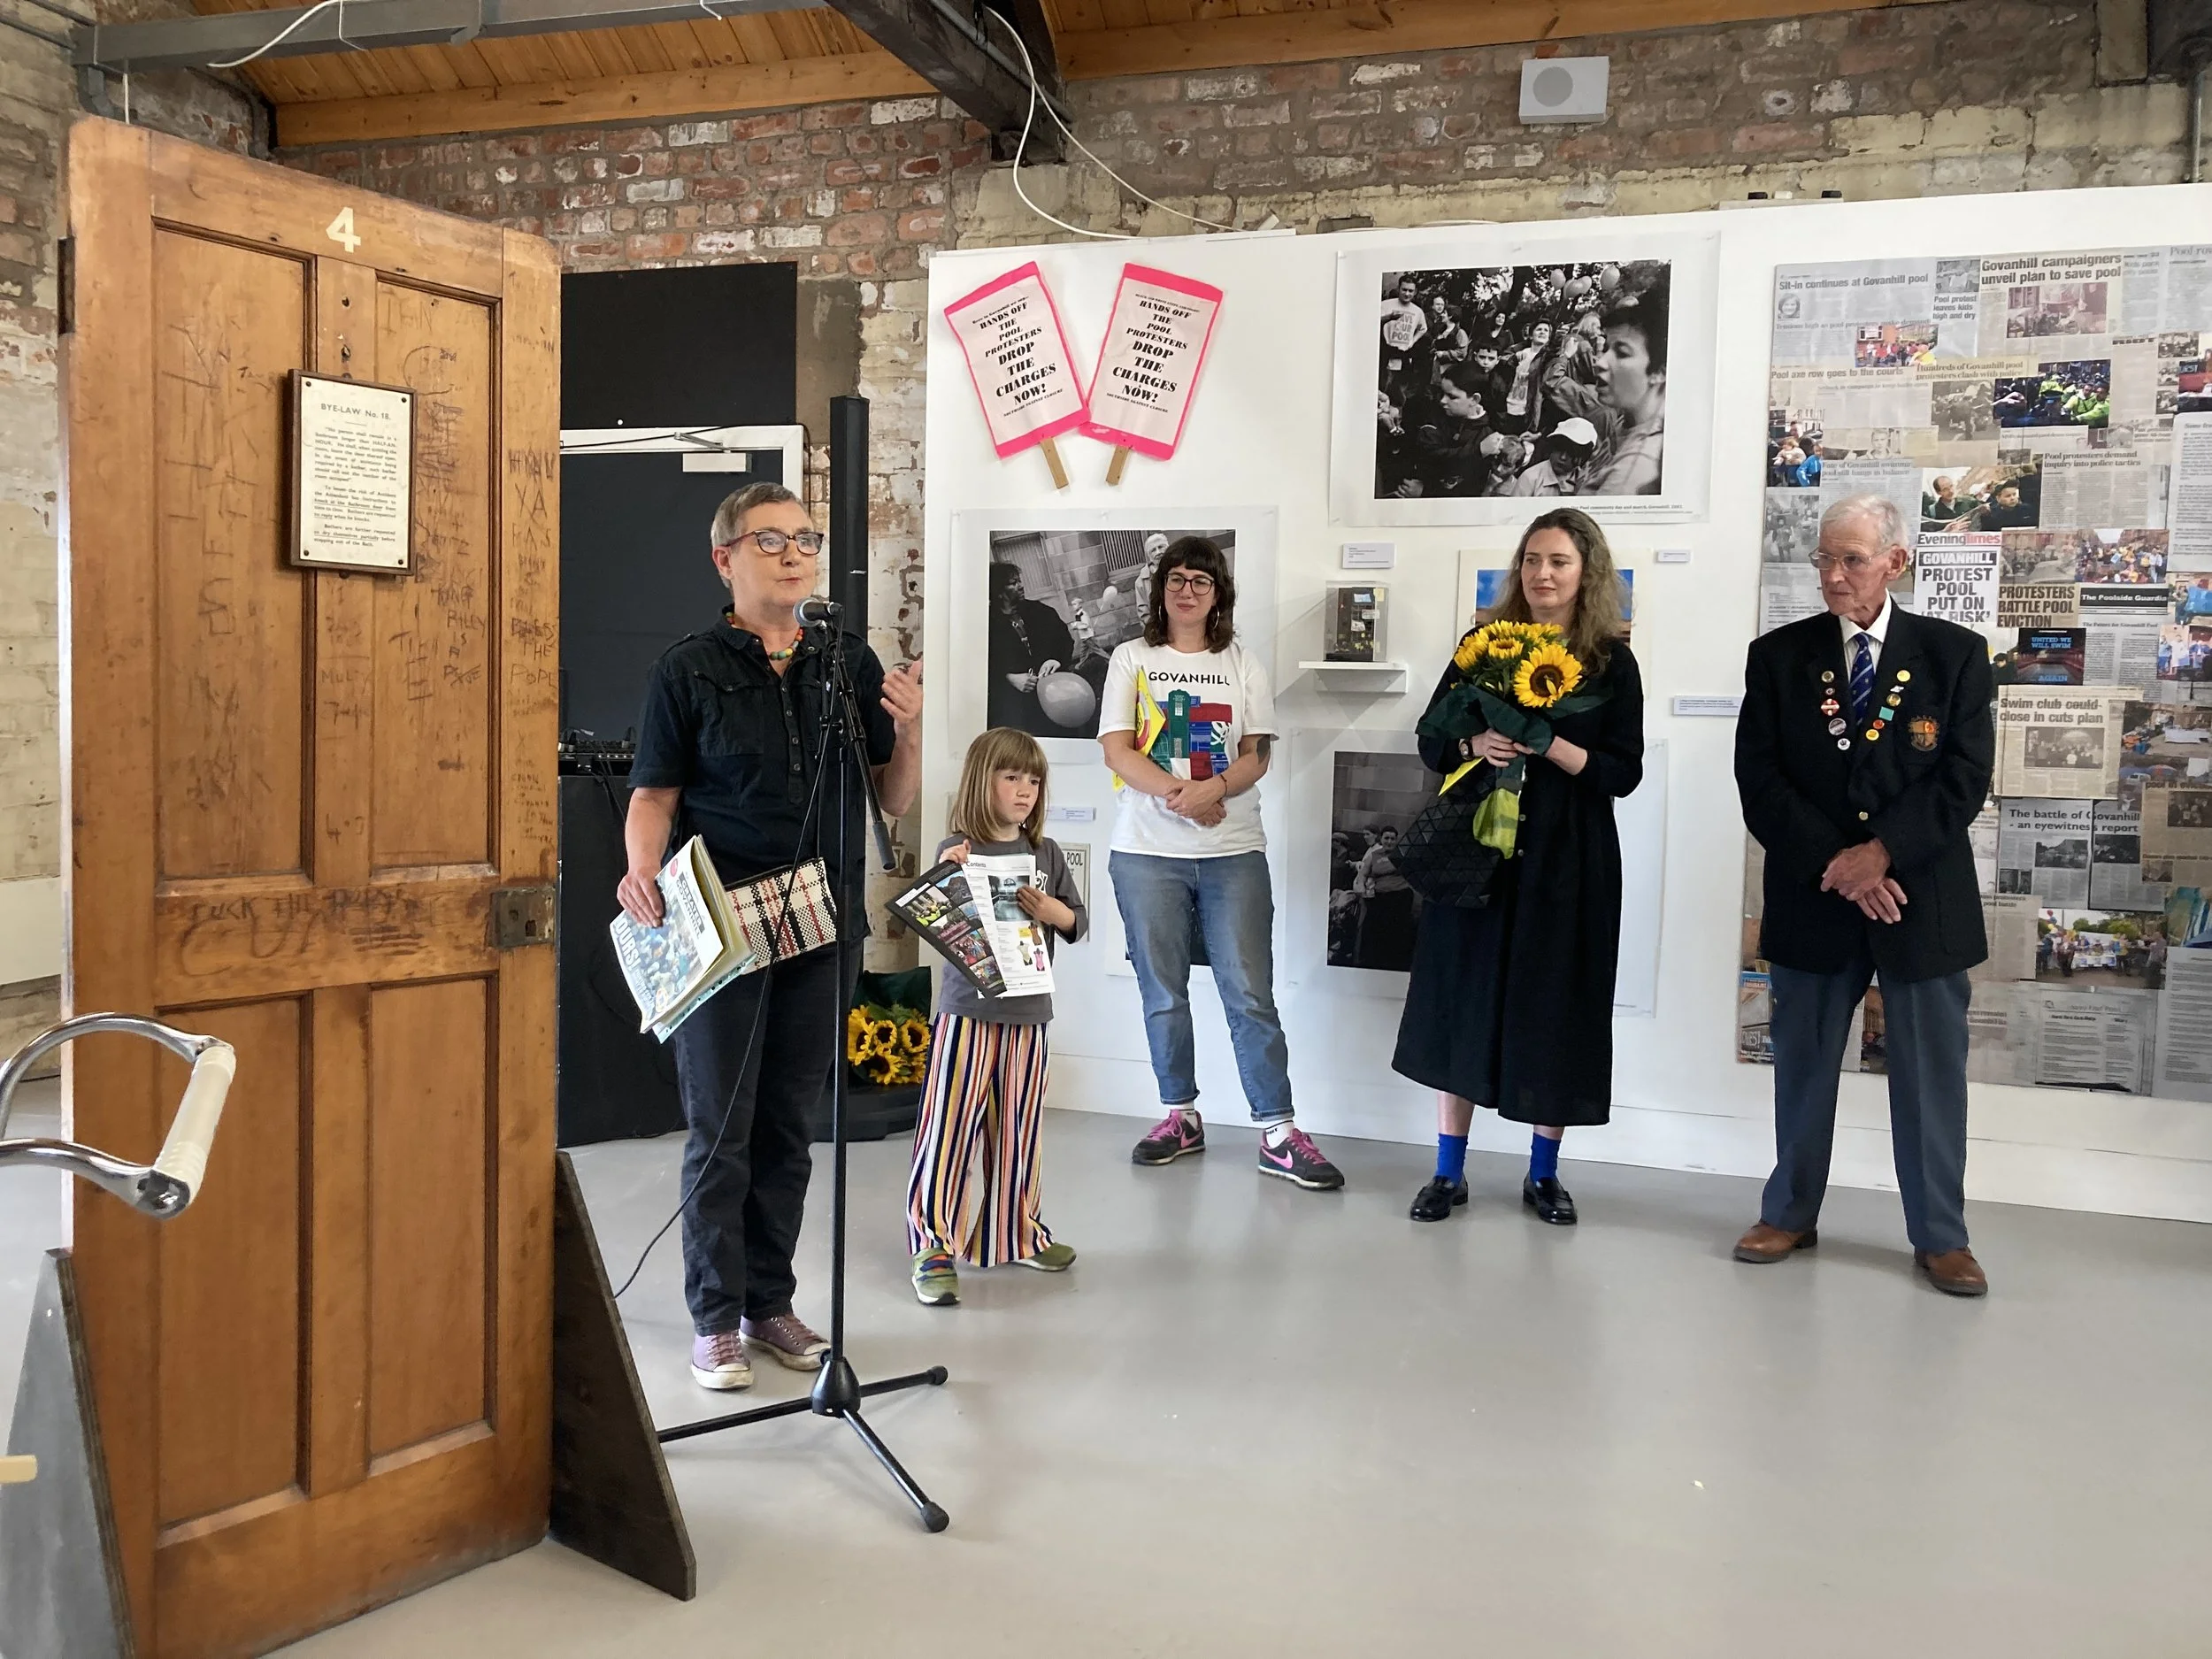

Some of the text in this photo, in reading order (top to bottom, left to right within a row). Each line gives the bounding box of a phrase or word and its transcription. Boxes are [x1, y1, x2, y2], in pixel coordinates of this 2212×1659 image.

[325, 206, 361, 253] 4
[1982, 257, 2038, 272] Govanhill
[2042, 254, 2122, 268] campaigners
[1779, 273, 1929, 290] Sit-in continues at Govanhill pool
[1981, 266, 2122, 285] unveil plan to save pool
[1951, 295, 1977, 303] protest
[980, 302, 1028, 329] HANDS OFF
[1139, 300, 1171, 313] HANDS
[1172, 308, 1192, 319] OFF
[1964, 311, 1976, 320] dry
[998, 318, 1018, 331] THE
[1152, 313, 1173, 325] THE
[999, 326, 1023, 342] POOL
[1147, 323, 1172, 335] POOL
[985, 326, 1042, 357] PROTESTERS
[1126, 327, 1188, 349] PROTESTERS
[997, 342, 1035, 365] DROP
[1133, 341, 1174, 359] DROP
[1007, 357, 1035, 377] THE
[1134, 356, 1164, 373] THE
[1966, 361, 2004, 370] Govanhill
[996, 363, 1056, 397] CHARGES
[1112, 366, 1178, 393] CHARGES
[1771, 371, 1789, 380] Pool
[1826, 370, 1846, 379] goes
[1014, 383, 1046, 405] NOW!
[1122, 384, 1159, 403] NOW!
[320, 403, 361, 415] BYE-LAW
[365, 410, 379, 419] No.
[2062, 452, 2103, 462] protesters
[2104, 450, 2138, 459] demand
[2044, 460, 2073, 469] inquiry
[2090, 459, 2114, 469] police
[1923, 552, 1993, 565] GOVANHILL
[1922, 567, 1993, 581] PROTEST
[1936, 582, 1977, 595] POOL
[1999, 586, 2075, 599] PROTESTERS
[1927, 596, 1985, 610] PUT ON
[1998, 600, 2074, 613] BATTLE POOL
[1997, 614, 2052, 627] EVICTION
[511, 664, 557, 689] POPE
[1148, 672, 1230, 686] GOVANHILL
[2001, 698, 2099, 710] Swim club could
[2000, 711, 2103, 725] close in cuts plan
[2008, 809, 2140, 821] The battle of Govanhill
[2034, 822, 2098, 832] eyewitness
[2101, 824, 2138, 833] report
[1066, 852, 1084, 866] POOL
[615, 918, 641, 972] OURS!
